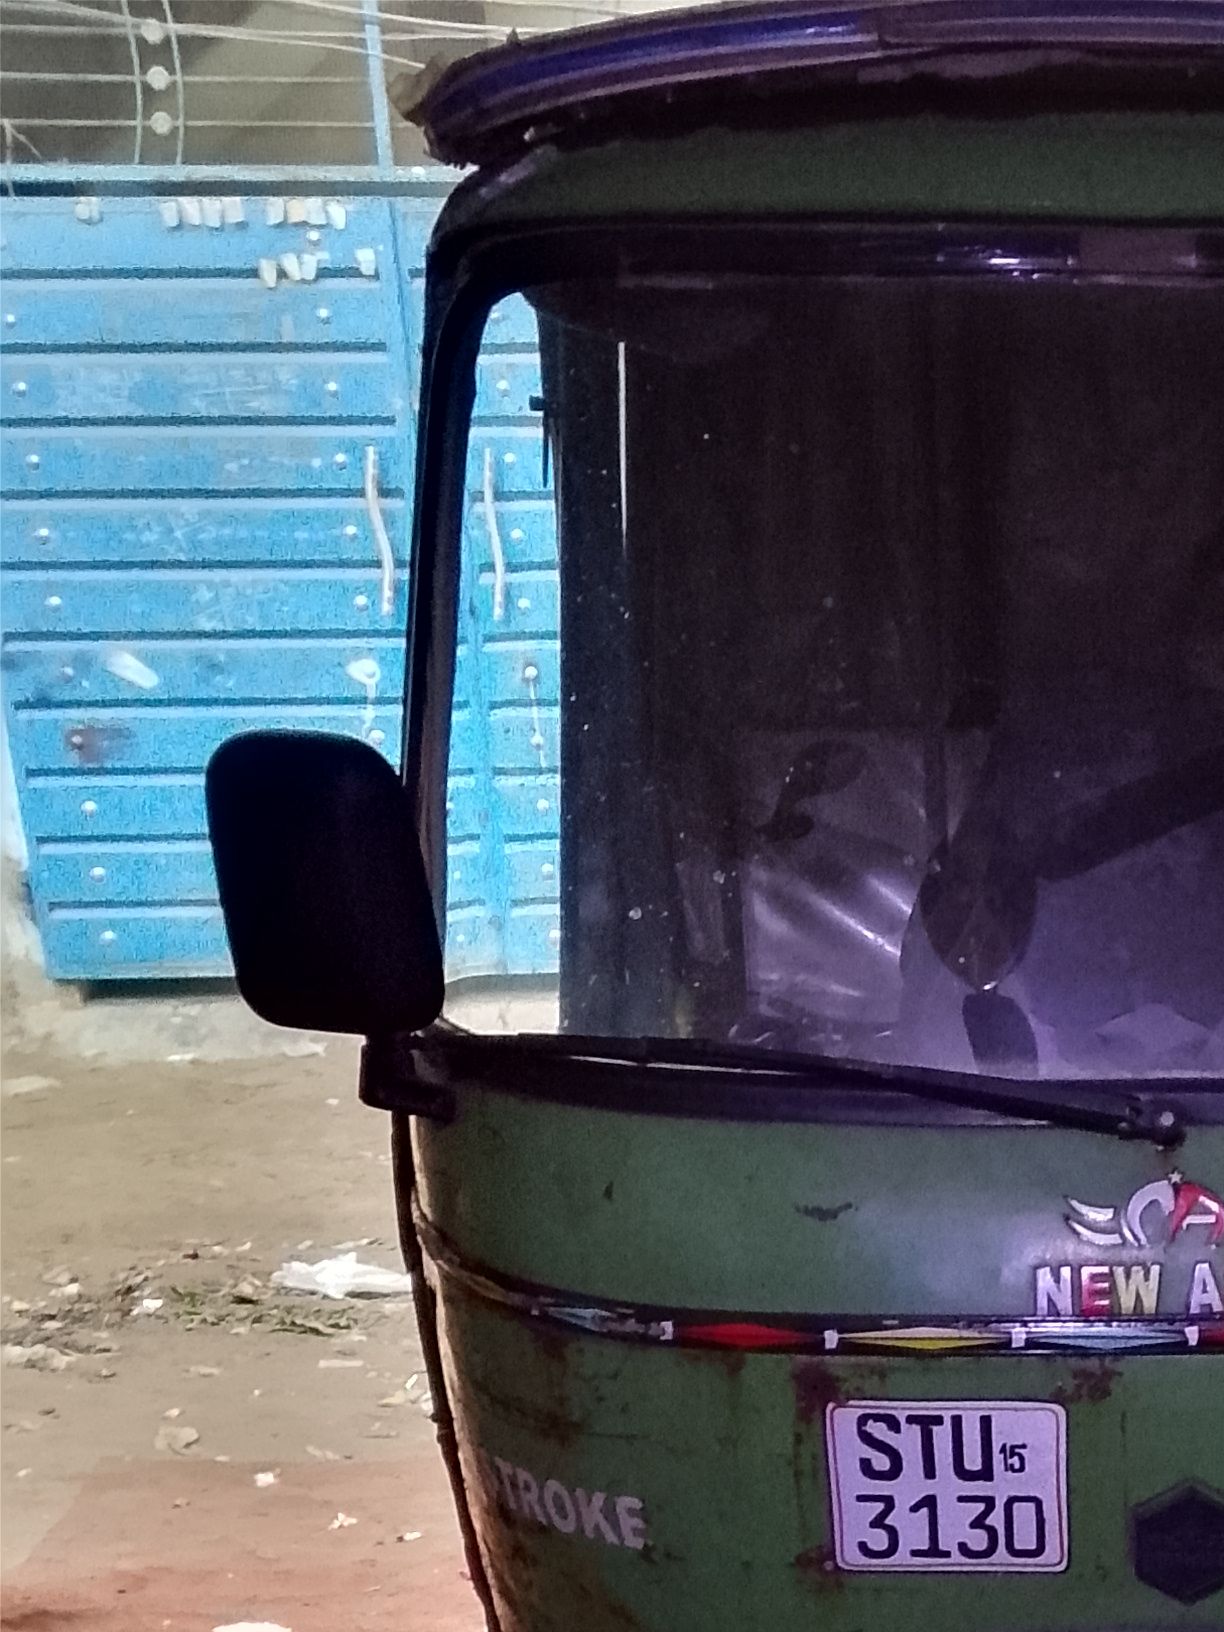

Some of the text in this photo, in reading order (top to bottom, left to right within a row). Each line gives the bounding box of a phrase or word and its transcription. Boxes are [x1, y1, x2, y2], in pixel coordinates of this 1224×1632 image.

[1035, 1263, 1162, 1317] NEW
[856, 1412, 1028, 1482] STU 15
[491, 1456, 648, 1550] TROKE
[855, 1494, 1047, 1560] 3130
